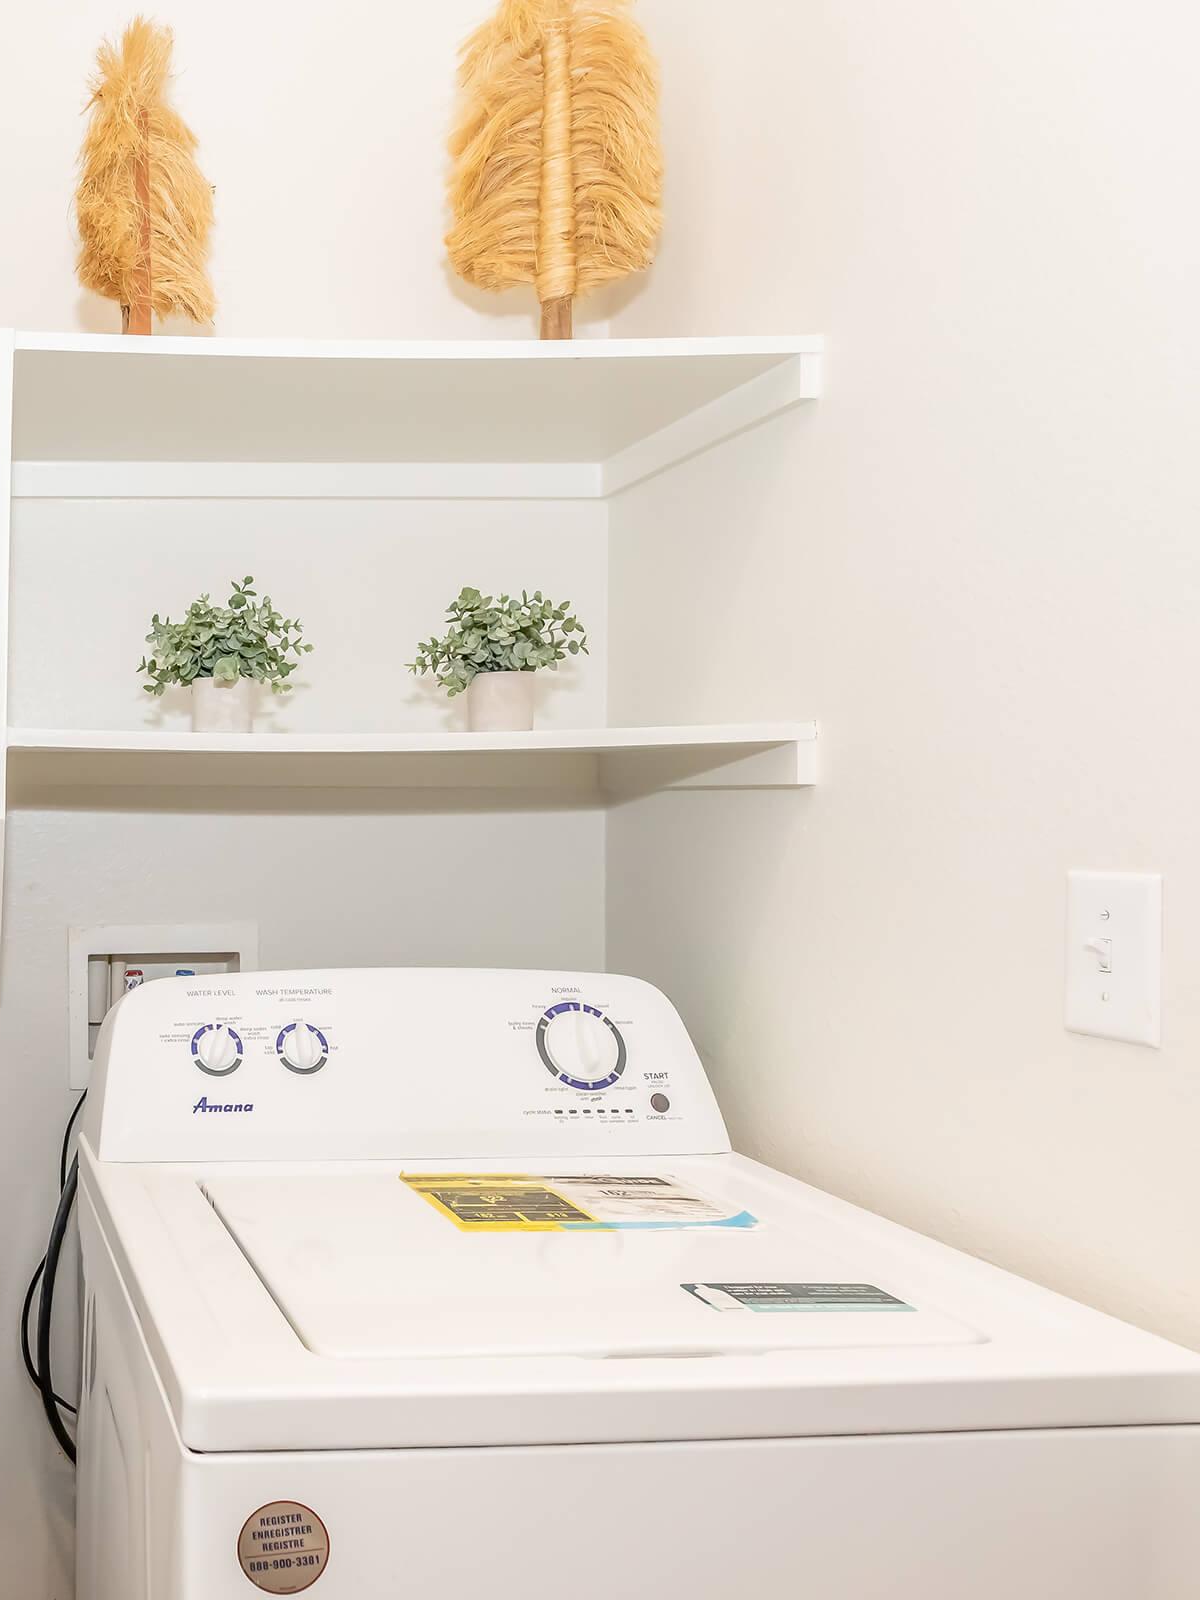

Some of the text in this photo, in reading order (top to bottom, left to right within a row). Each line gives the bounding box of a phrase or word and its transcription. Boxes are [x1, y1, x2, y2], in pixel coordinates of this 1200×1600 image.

[186, 989, 237, 998] WATER LEVEL
[255, 988, 334, 996] WASH TEMPERATURE
[643, 1072, 669, 1080] START
[192, 1096, 254, 1114] Amana
[260, 1513, 303, 1527] REGISTER
[252, 1525, 313, 1541] ENREGISTRER
[262, 1538, 305, 1553] REGISTRE
[249, 1554, 321, 1573] 888-900-3381
